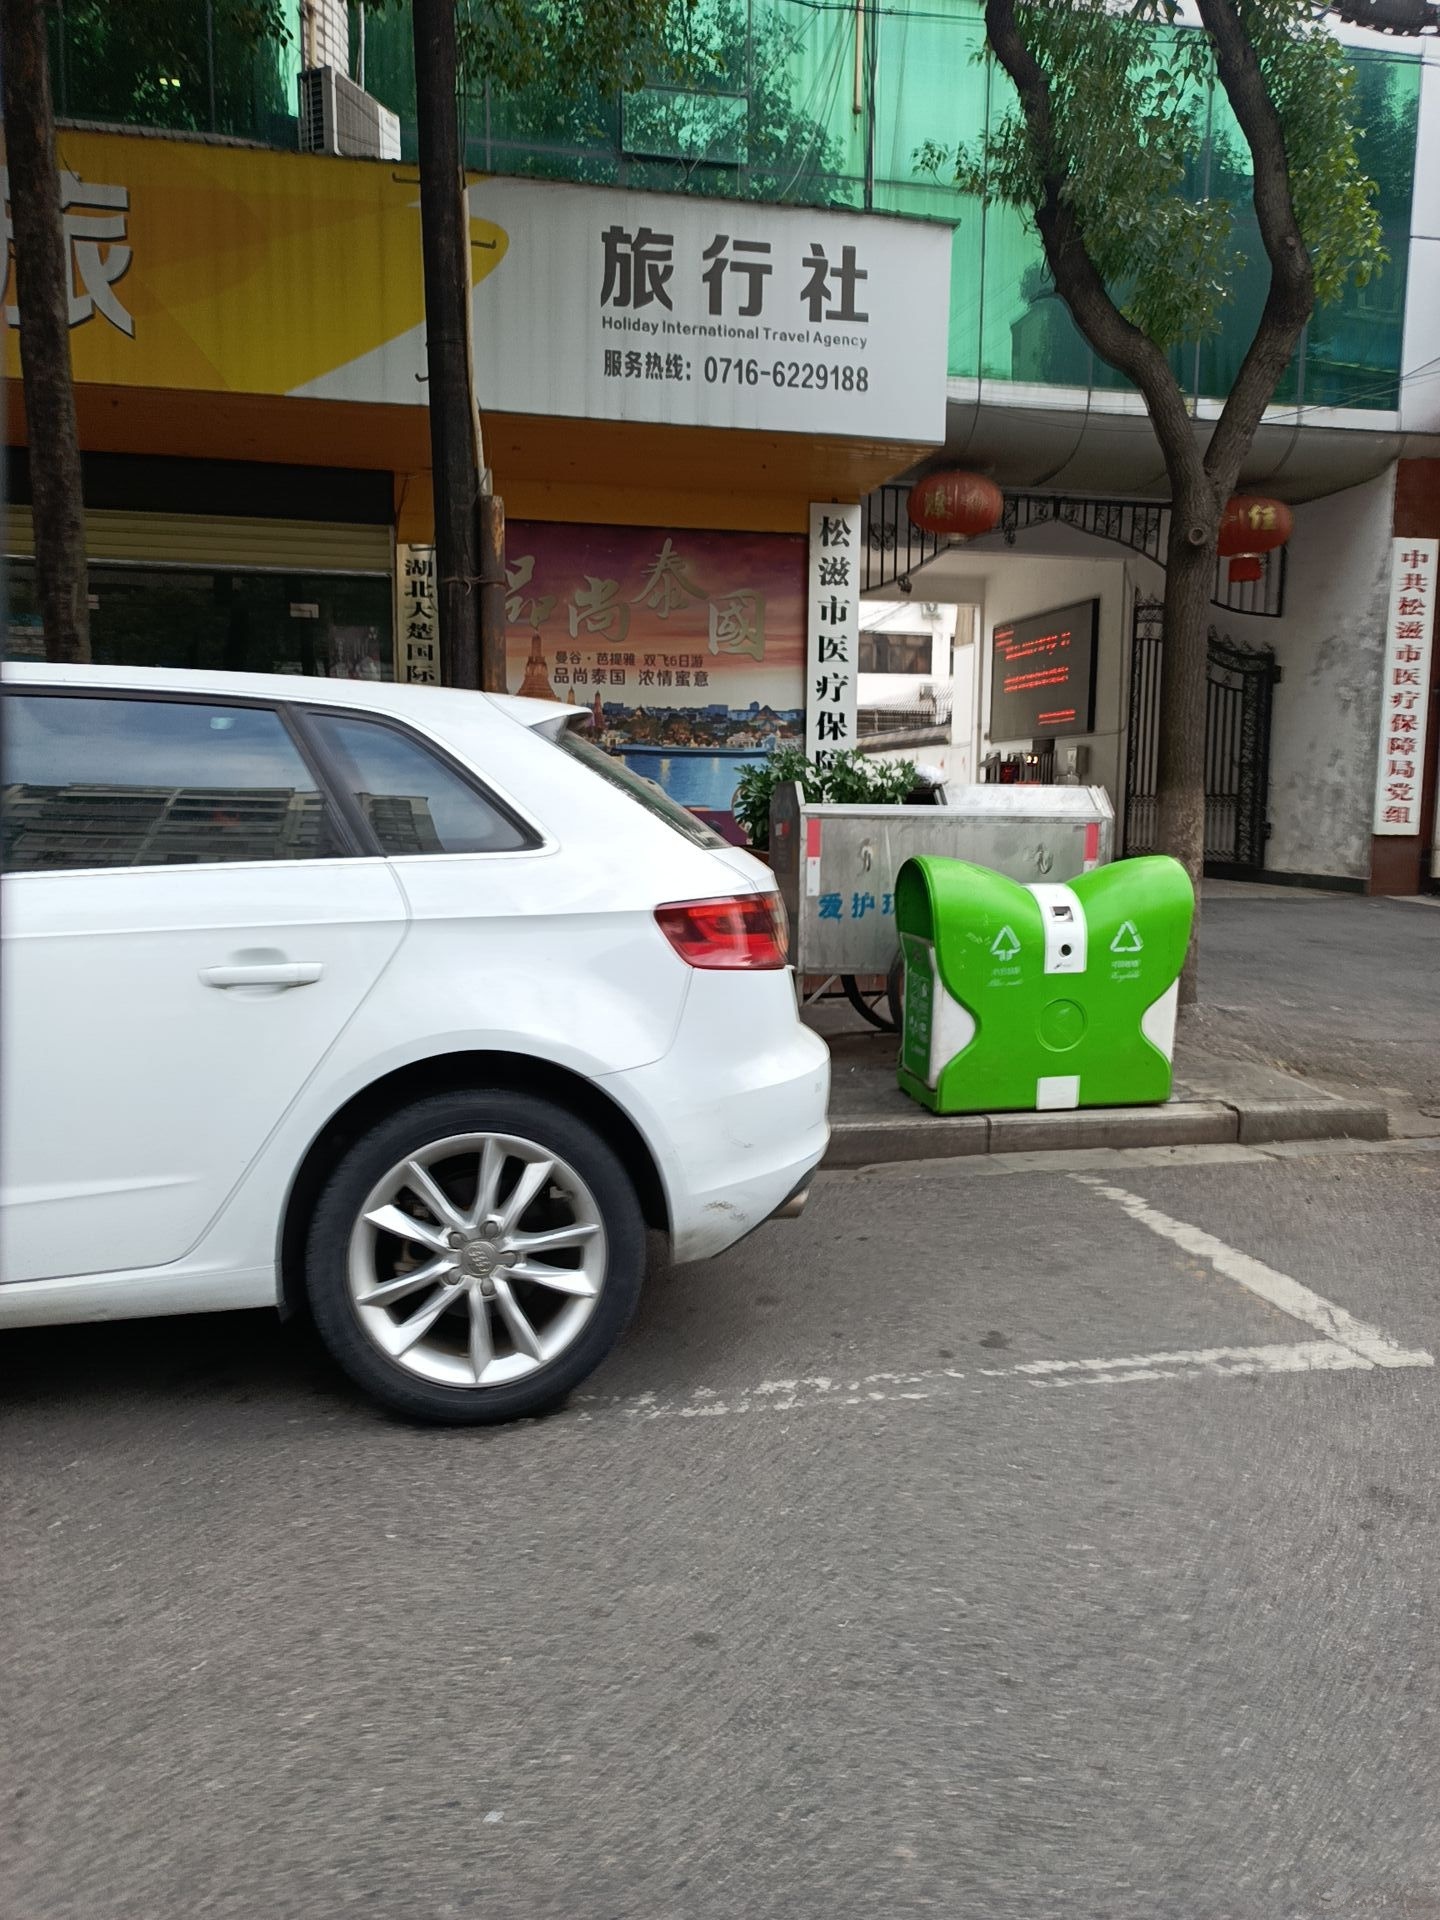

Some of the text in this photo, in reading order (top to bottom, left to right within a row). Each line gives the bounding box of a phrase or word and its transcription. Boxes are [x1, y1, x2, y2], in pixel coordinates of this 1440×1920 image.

[599, 225, 870, 323] 旅行社
[602, 316, 867, 350] Holiday International Travel Agency
[704, 356, 869, 393] 0716-6229188
[404, 559, 435, 683] 湖北大楚国际
[553, 667, 709, 688] 品尚泰国 浓情蜜意
[1382, 549, 1429, 825] 中共松滋市医疗保障局党组
